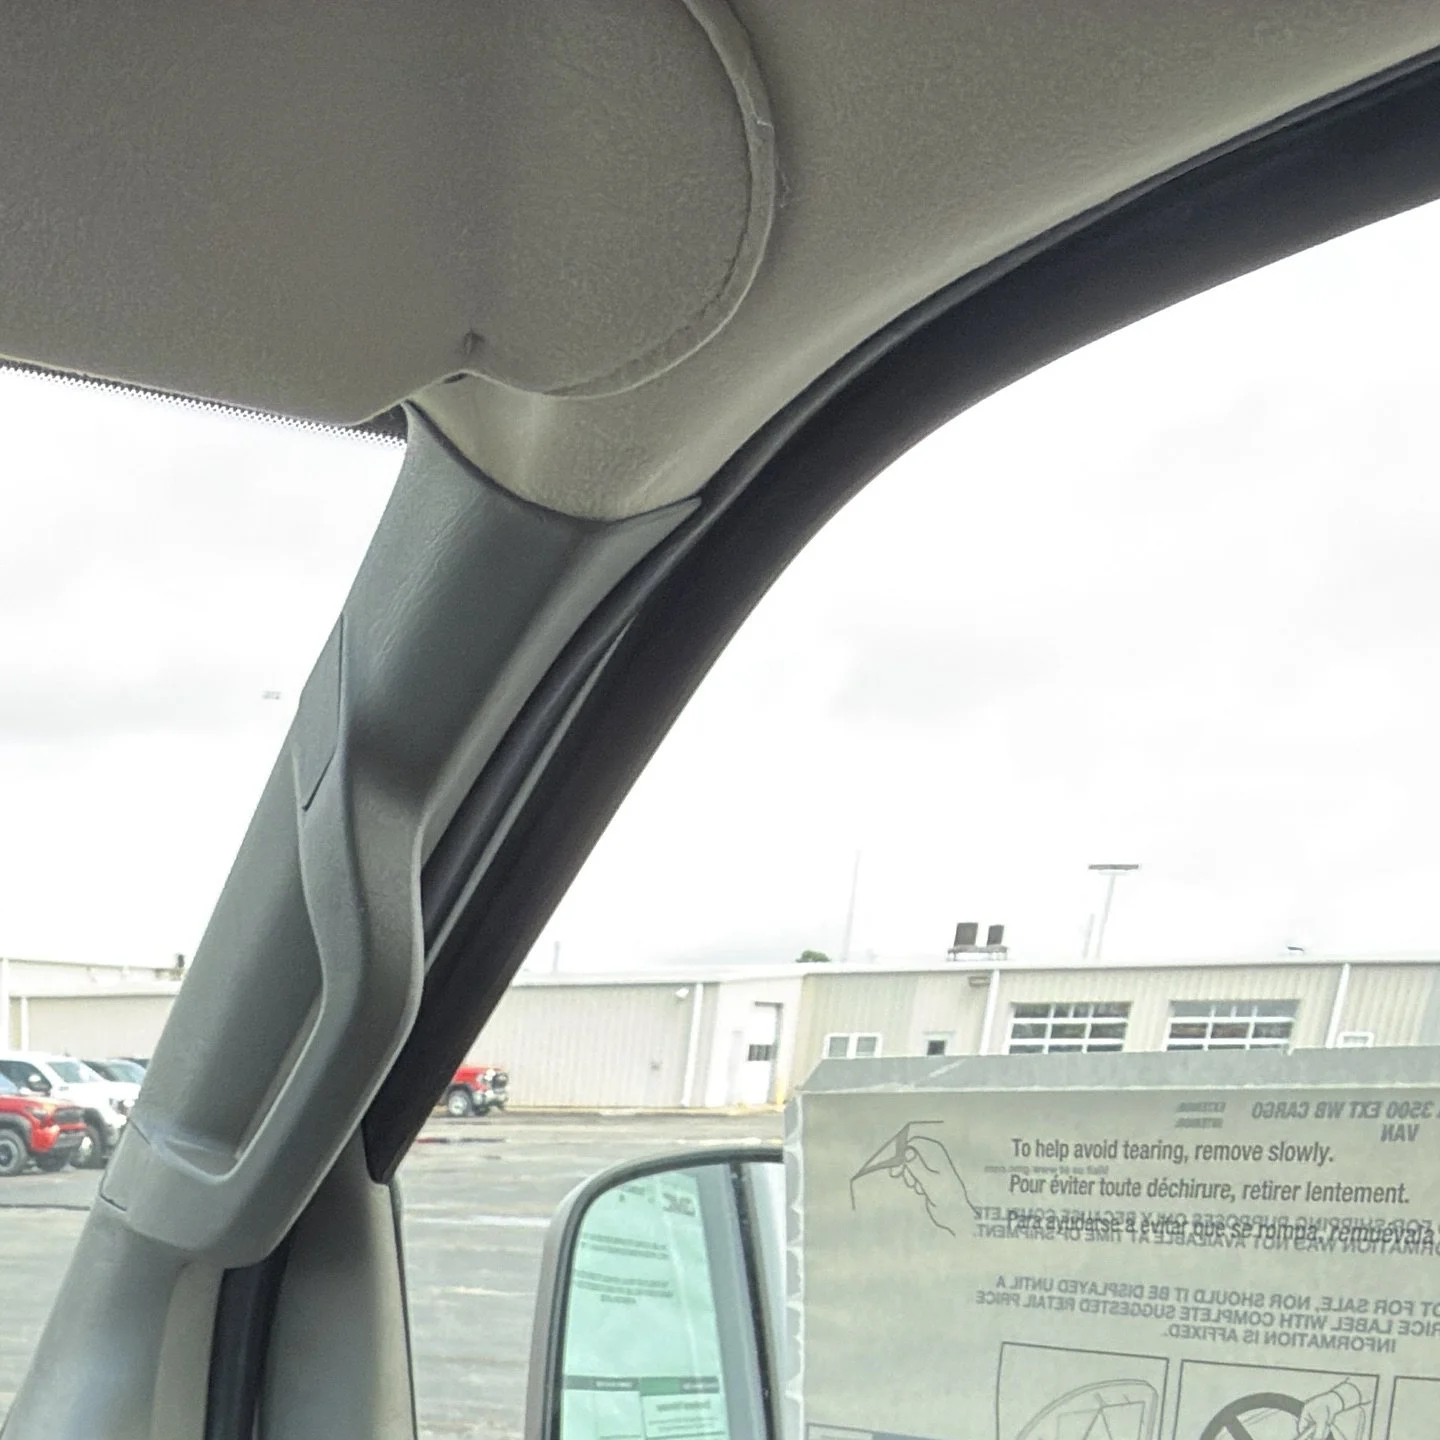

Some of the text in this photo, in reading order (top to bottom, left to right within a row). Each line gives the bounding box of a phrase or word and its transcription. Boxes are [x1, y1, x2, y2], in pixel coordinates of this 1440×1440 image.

[1012, 1139, 1334, 1167] To help avoid tearing, remove slowly.
[1009, 1175, 1410, 1204] Pour éviter toute déchirure, retirer lentement.
